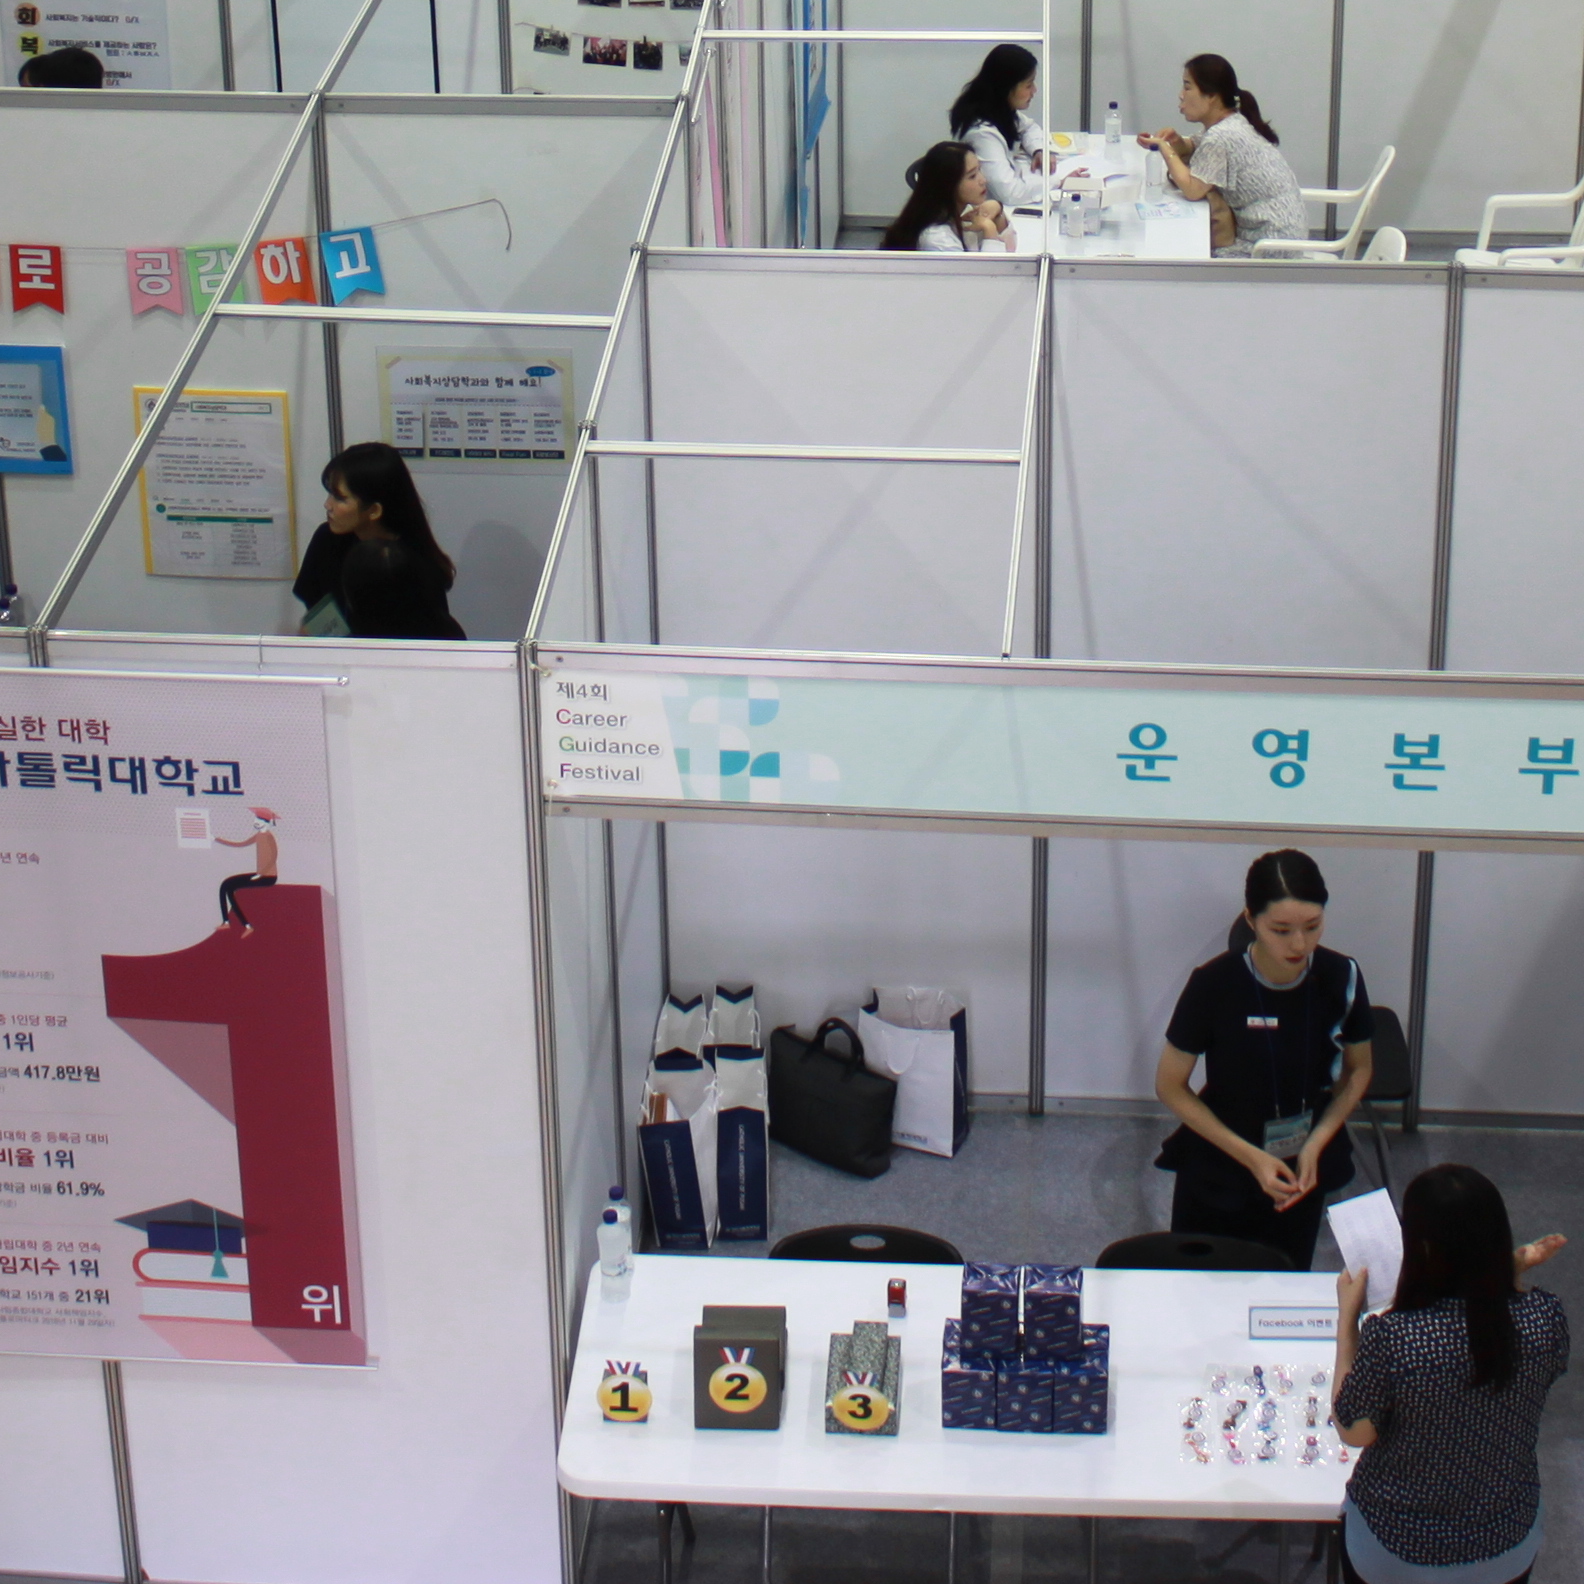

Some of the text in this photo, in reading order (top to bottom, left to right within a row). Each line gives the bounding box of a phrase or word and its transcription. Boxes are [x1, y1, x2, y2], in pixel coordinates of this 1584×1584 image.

[17, 7, 38, 26] 회
[20, 37, 39, 54] 복
[135, 233, 372, 298] 공감하고
[494, 375, 515, 388] 함께
[519, 374, 542, 389] 해요!
[556, 681, 608, 701] 제4회
[556, 709, 627, 727] Career
[57, 717, 111, 746] 대학
[559, 736, 660, 755] Guidance
[1117, 722, 1579, 795] 운영본부
[560, 763, 640, 782] Festival
[16, 853, 40, 865] 연속
[2, 1032, 34, 1052] 1위
[23, 1065, 101, 1083] 417.8만원
[43, 1149, 75, 1169] 1위
[56, 1181, 105, 1198] 61.9%
[56, 1239, 76, 1252] 2년
[80, 1240, 101, 1253] 연속
[68, 1258, 100, 1278] 1위
[26, 1289, 55, 1302] 151개
[75, 1288, 110, 1305] 21위
[302, 1284, 342, 1324] 위
[724, 1374, 750, 1401] 2
[609, 1383, 639, 1412] 1
[847, 1394, 874, 1419] 3
